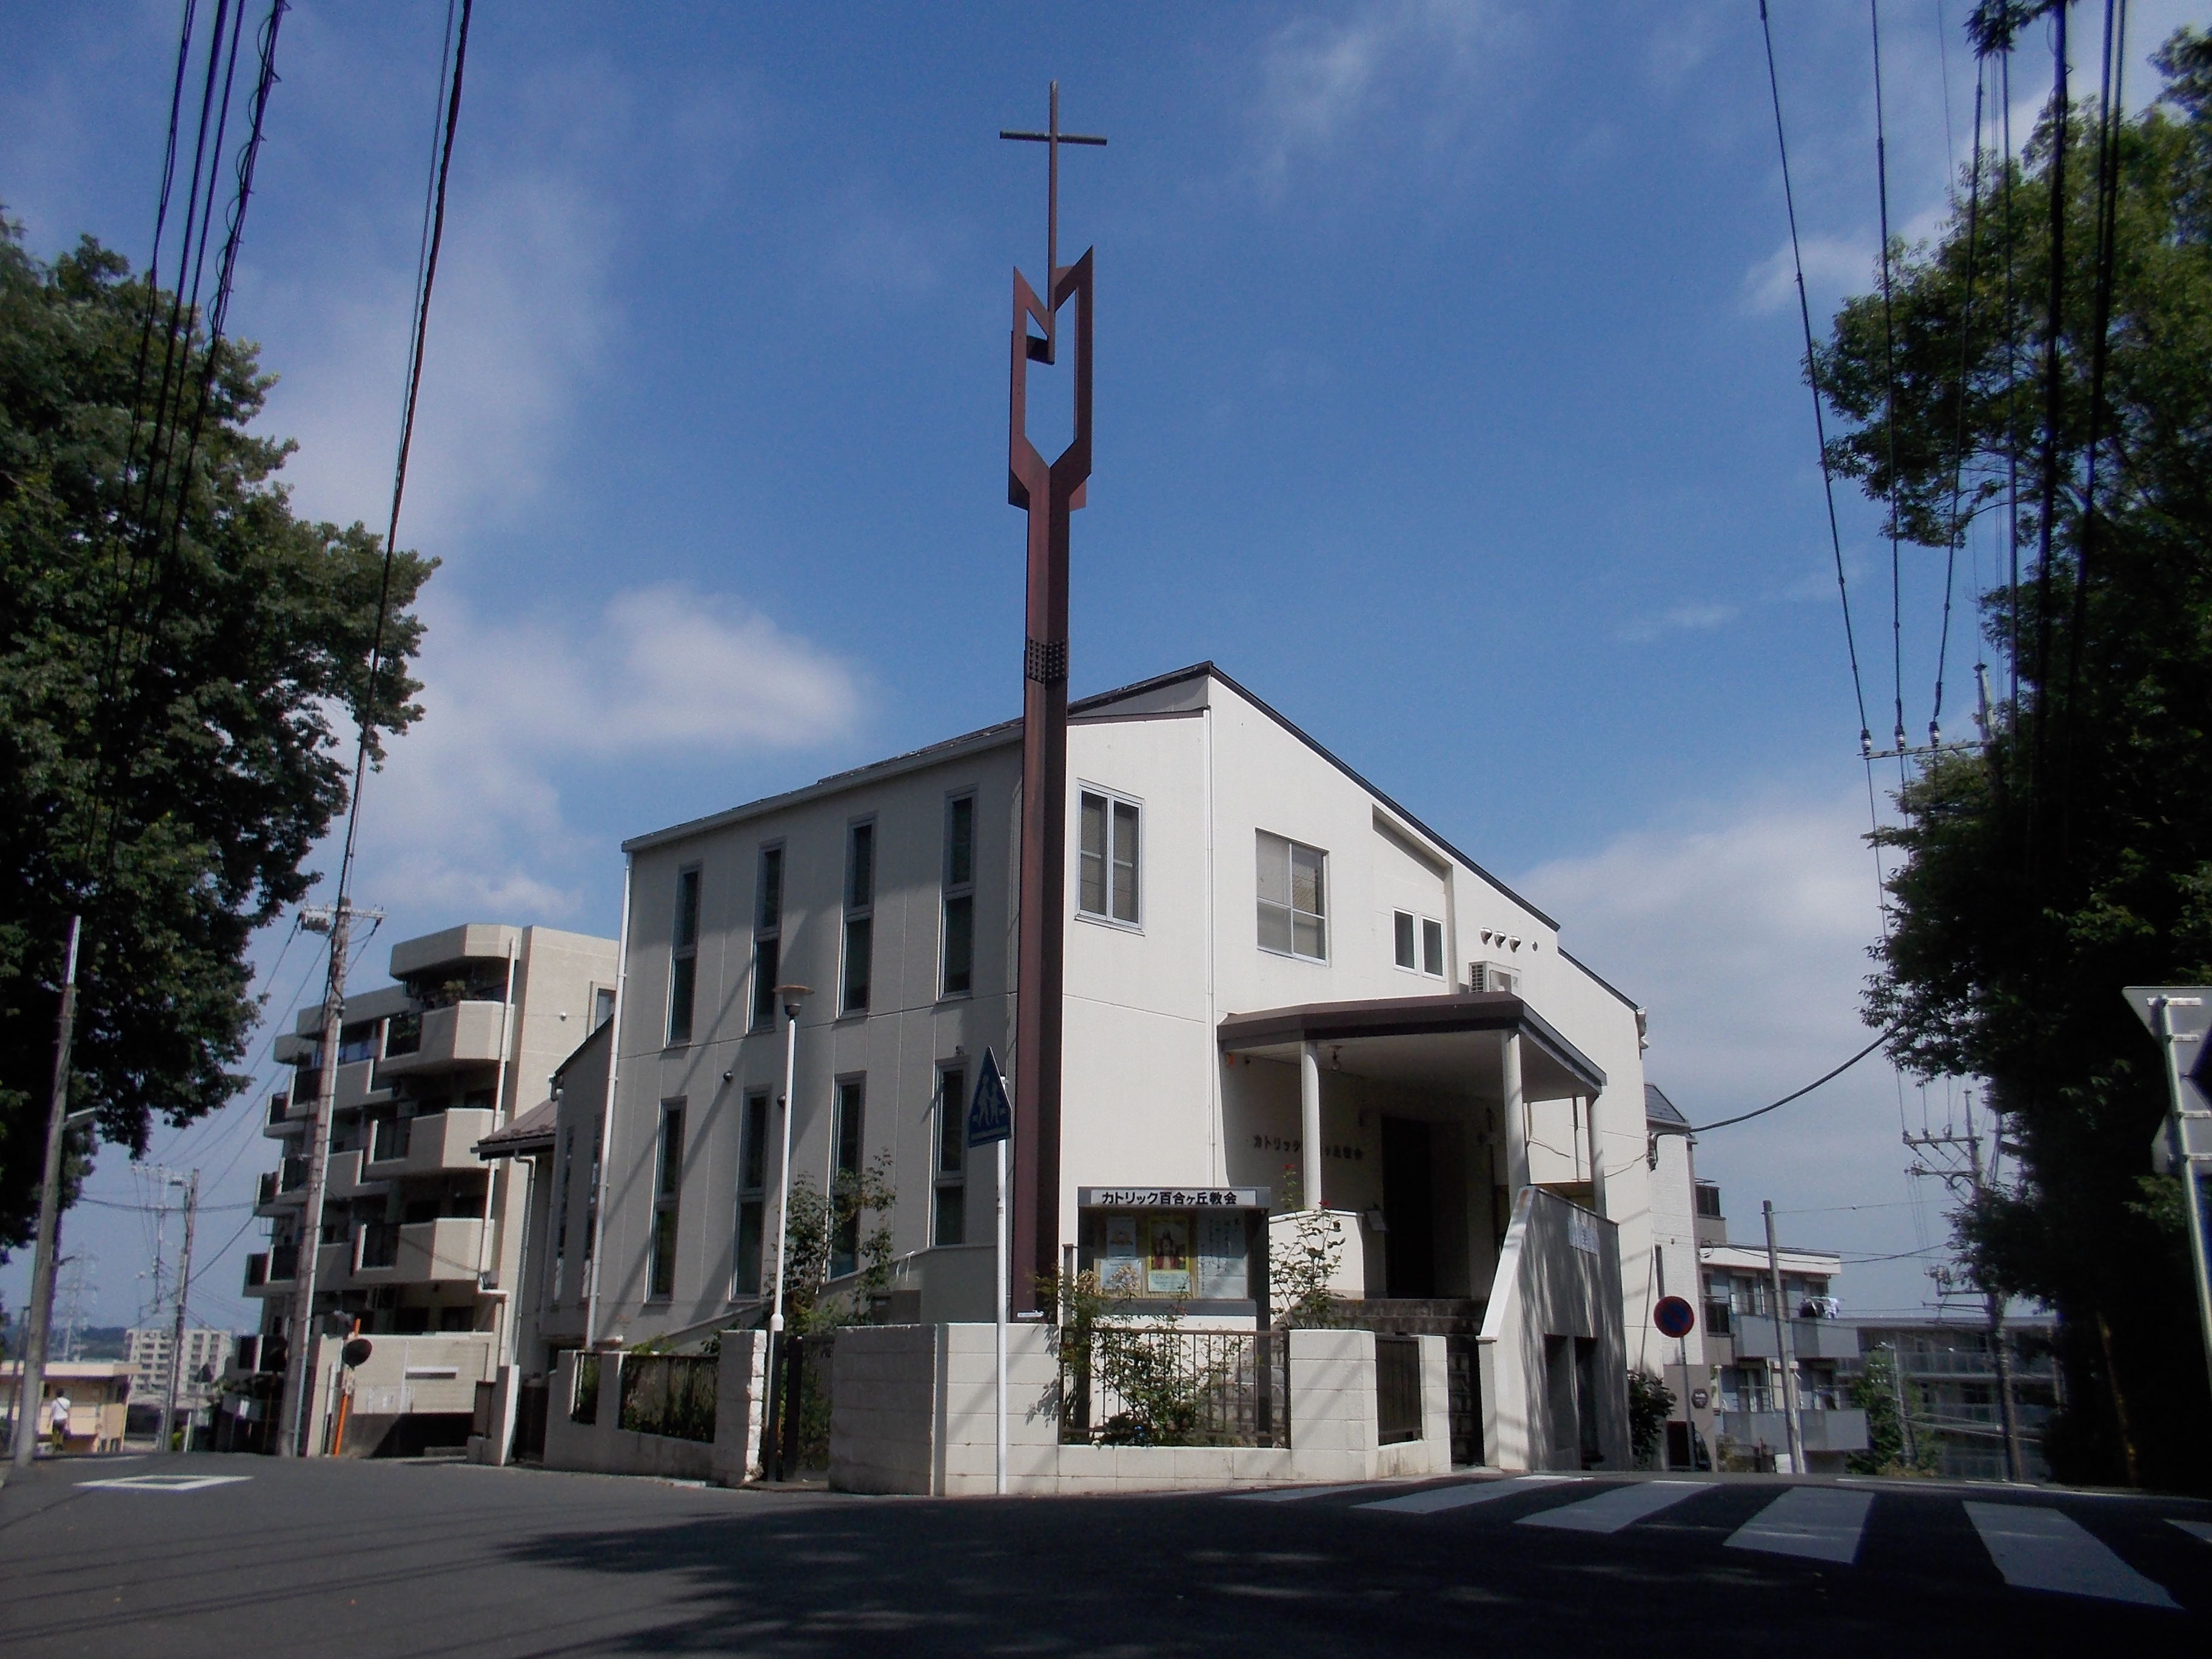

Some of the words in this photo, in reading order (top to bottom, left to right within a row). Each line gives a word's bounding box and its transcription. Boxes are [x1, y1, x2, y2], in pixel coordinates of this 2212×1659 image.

[1102, 1191, 1236, 1205] カトリック百合ヶ丘教会
